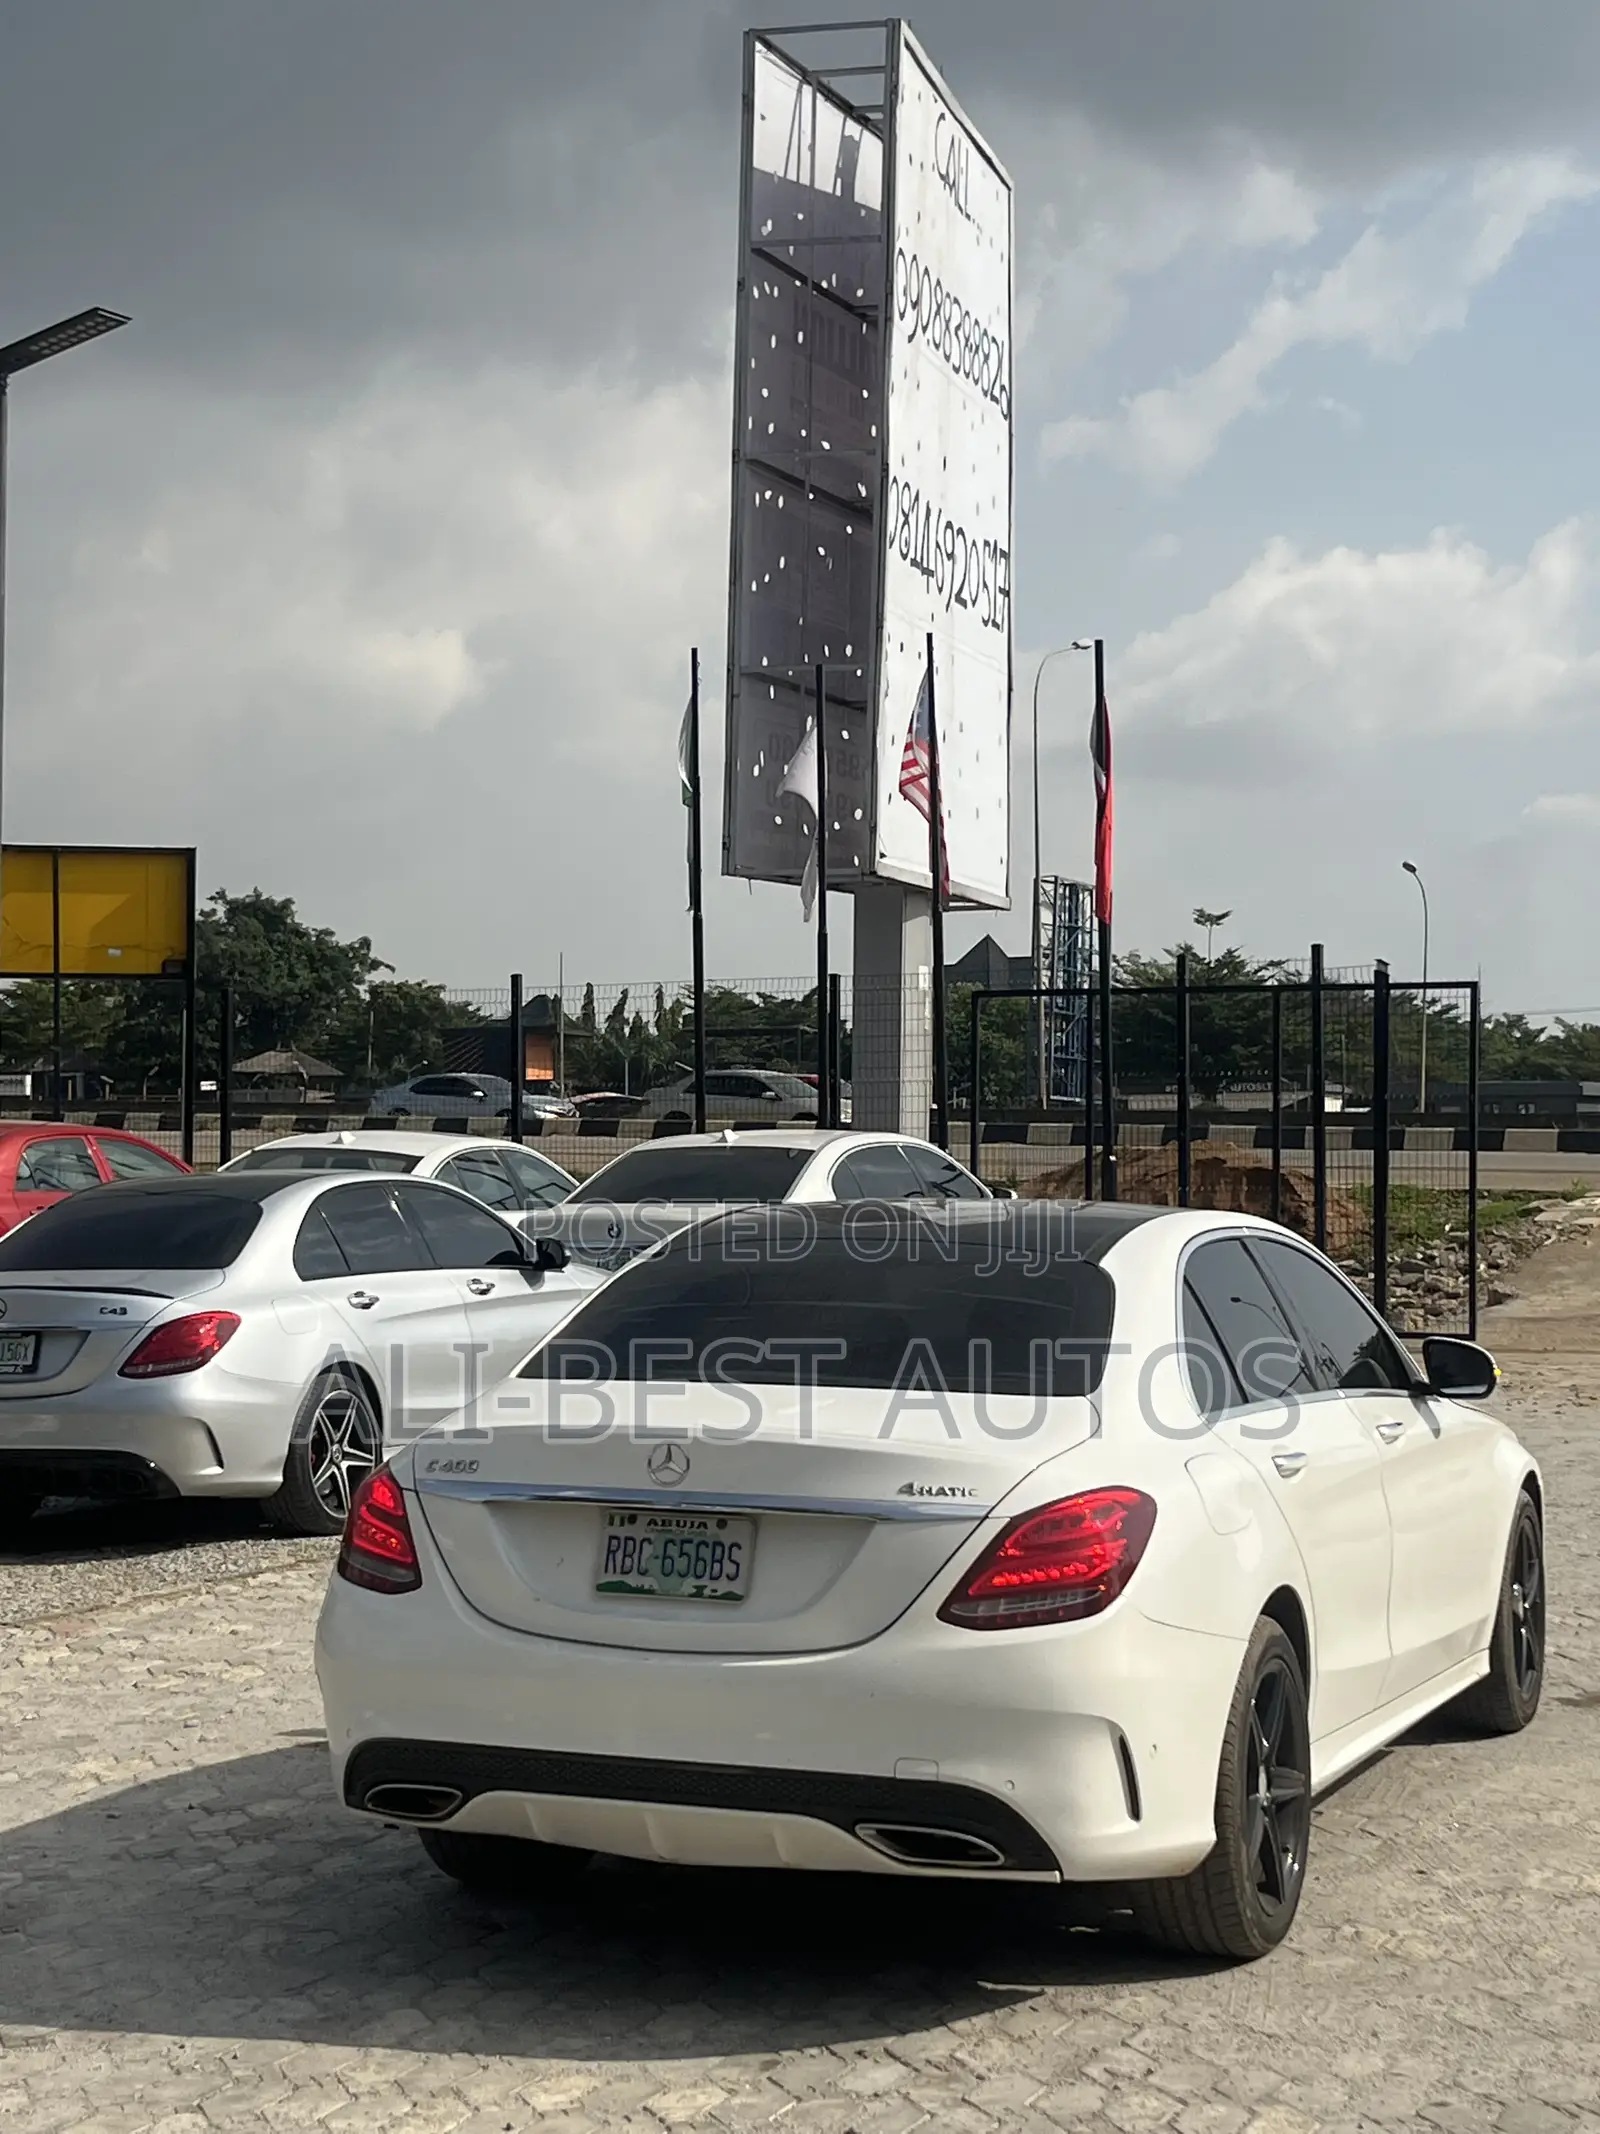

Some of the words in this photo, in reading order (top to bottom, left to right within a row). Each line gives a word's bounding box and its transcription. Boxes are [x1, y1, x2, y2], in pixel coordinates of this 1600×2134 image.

[889, 475, 1010, 633] 08146920517
[99, 1306, 128, 1316] C43
[897, 1481, 979, 1498] 4MATIC
[646, 1517, 709, 1530] ABUJA
[604, 1535, 742, 1582] RBC-656BS
